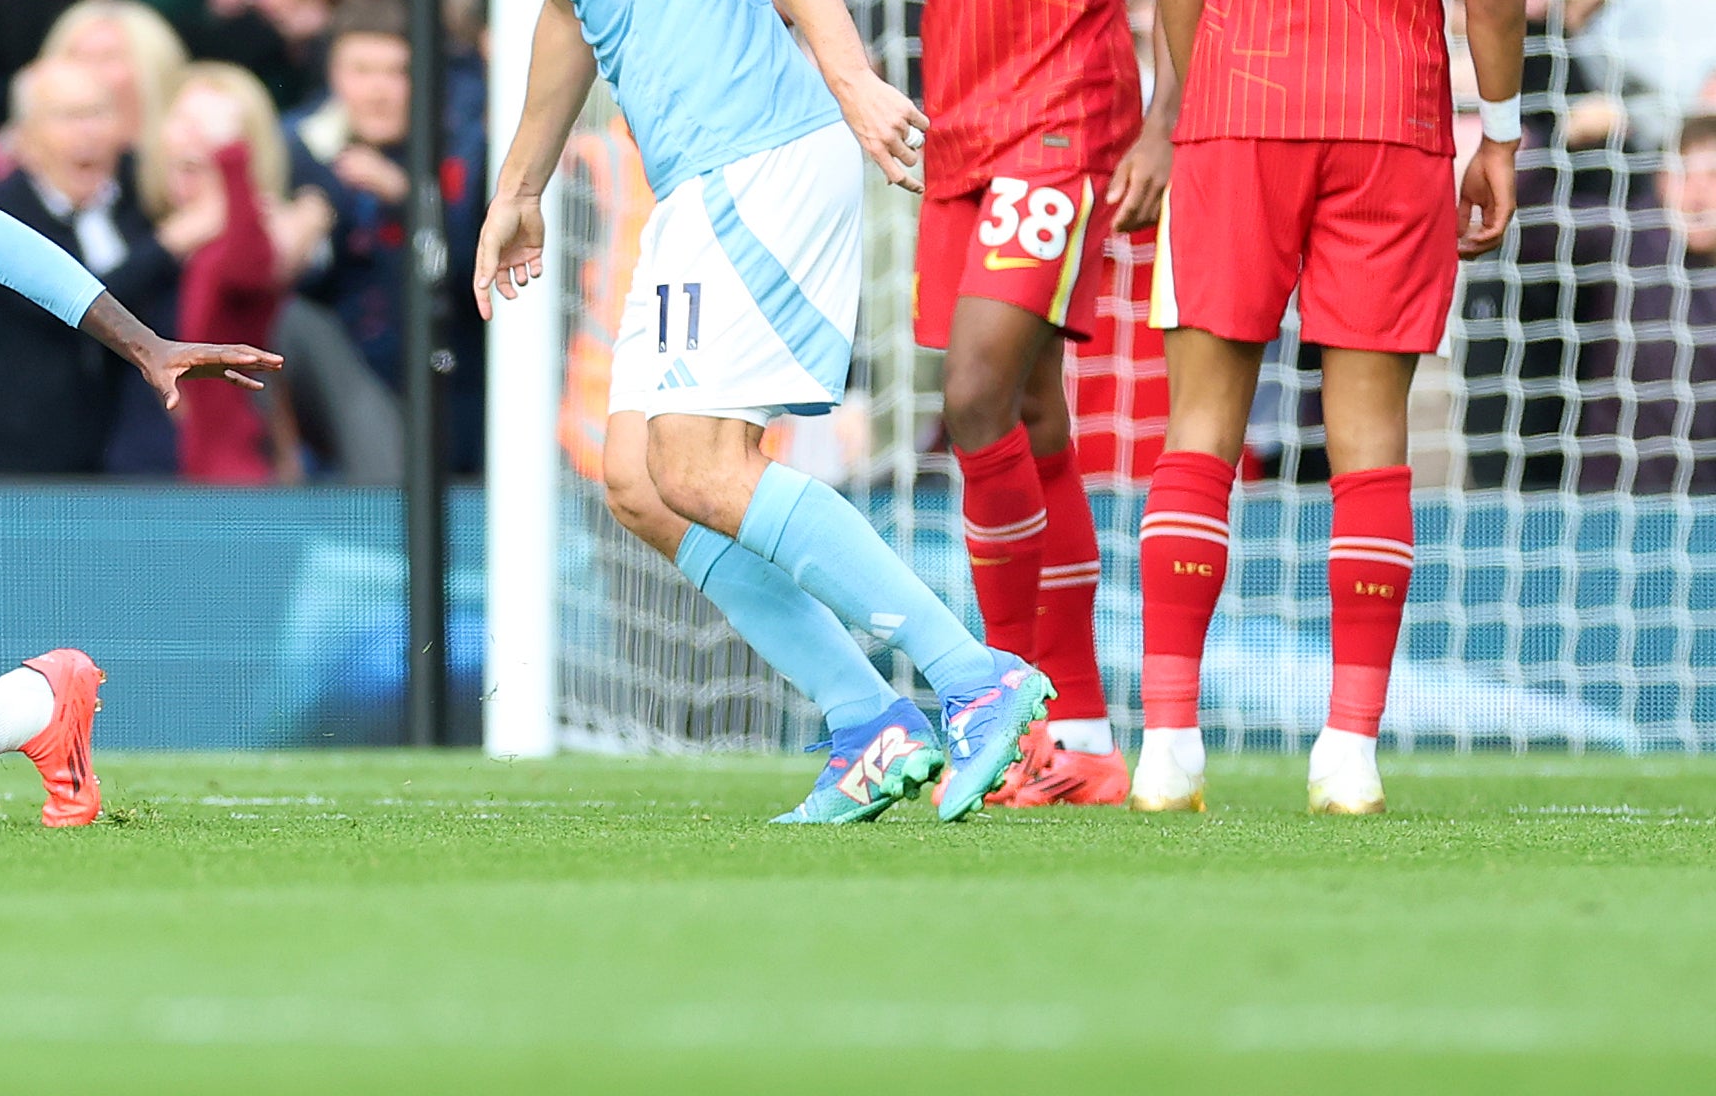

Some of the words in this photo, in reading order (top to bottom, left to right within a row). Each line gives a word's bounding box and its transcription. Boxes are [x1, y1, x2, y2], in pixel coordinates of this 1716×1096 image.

[978, 176, 1076, 262] 38
[656, 283, 702, 354] 11
[1173, 560, 1213, 578] LFC
[1355, 580, 1395, 599] LFC
